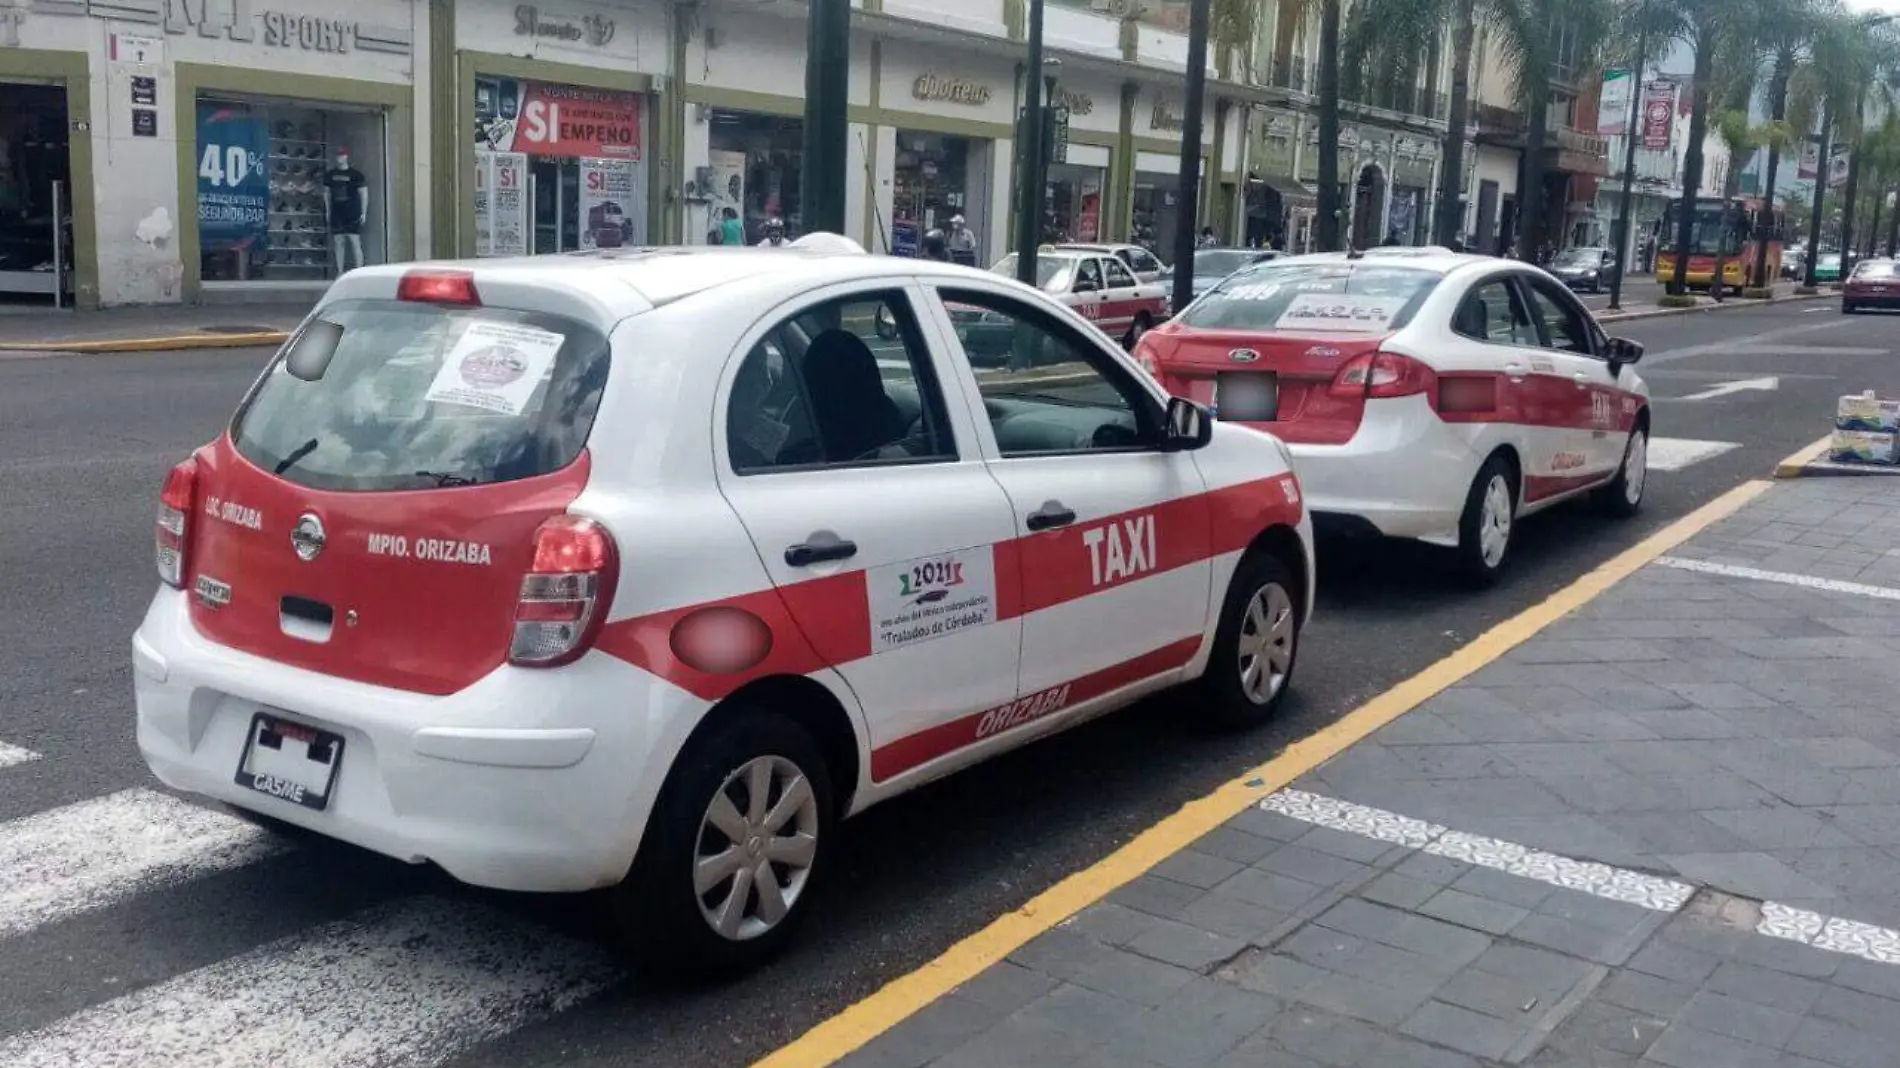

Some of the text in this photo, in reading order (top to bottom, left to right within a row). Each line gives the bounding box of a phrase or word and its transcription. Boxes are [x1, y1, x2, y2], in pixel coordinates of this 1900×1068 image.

[264, 11, 348, 54] SPORT
[524, 101, 559, 143] SI
[200, 143, 264, 188] 40%
[501, 168, 518, 187] SI
[587, 171, 605, 190] SI
[222, 501, 262, 531] ORIZABA
[368, 532, 491, 566] MPIO. ORIZABA
[1083, 514, 1156, 586] TAXI
[913, 560, 952, 588] 2021
[975, 684, 1072, 739] ORIZABA
